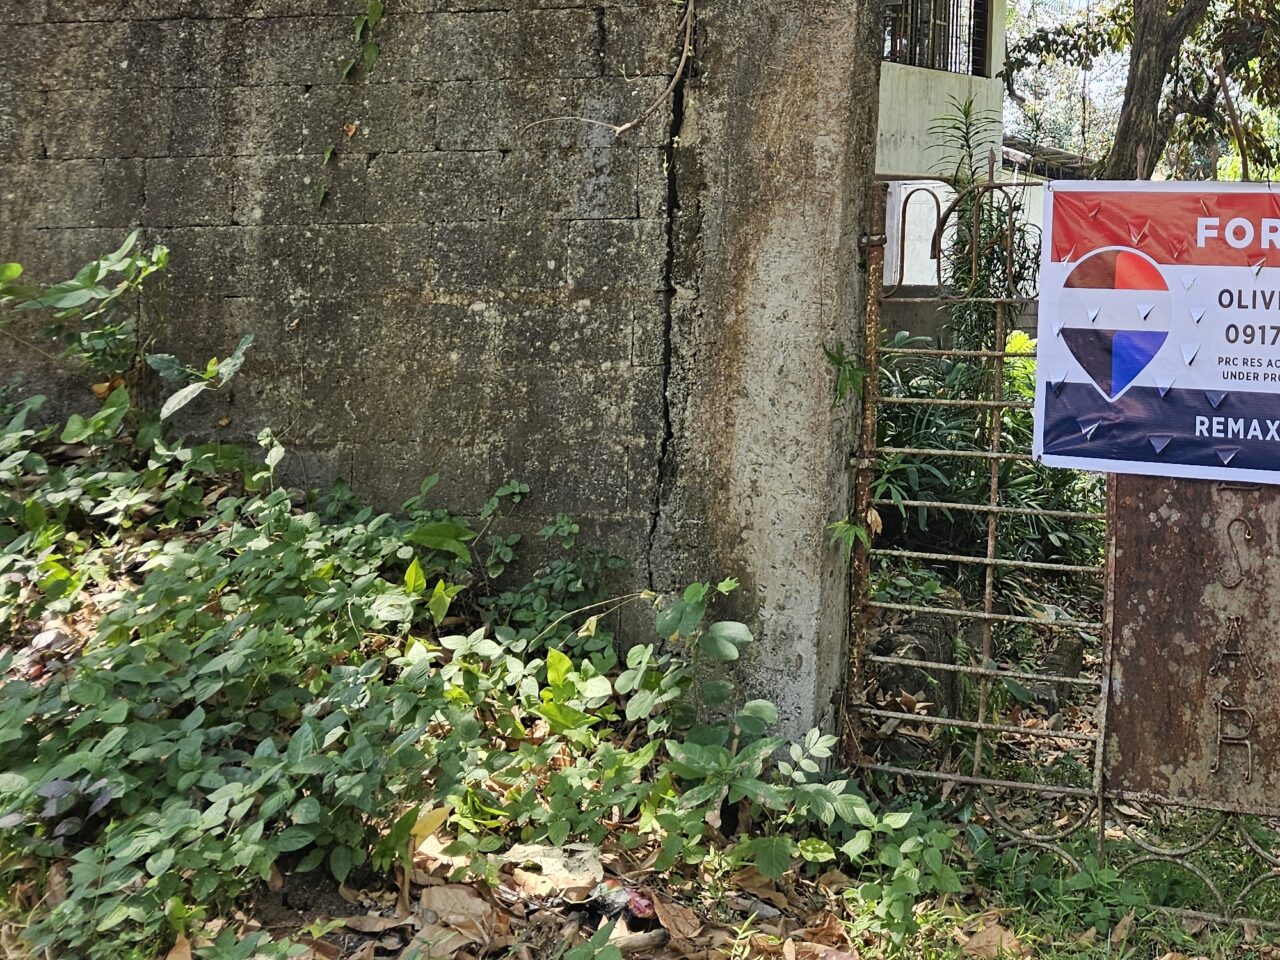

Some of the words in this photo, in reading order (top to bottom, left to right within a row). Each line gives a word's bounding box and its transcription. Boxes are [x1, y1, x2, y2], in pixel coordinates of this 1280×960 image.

[1217, 356, 1239, 367] PRC
[1242, 357, 1263, 368] RES
[1222, 370, 1259, 382] UNDER
[1195, 415, 1280, 442] REMAX
